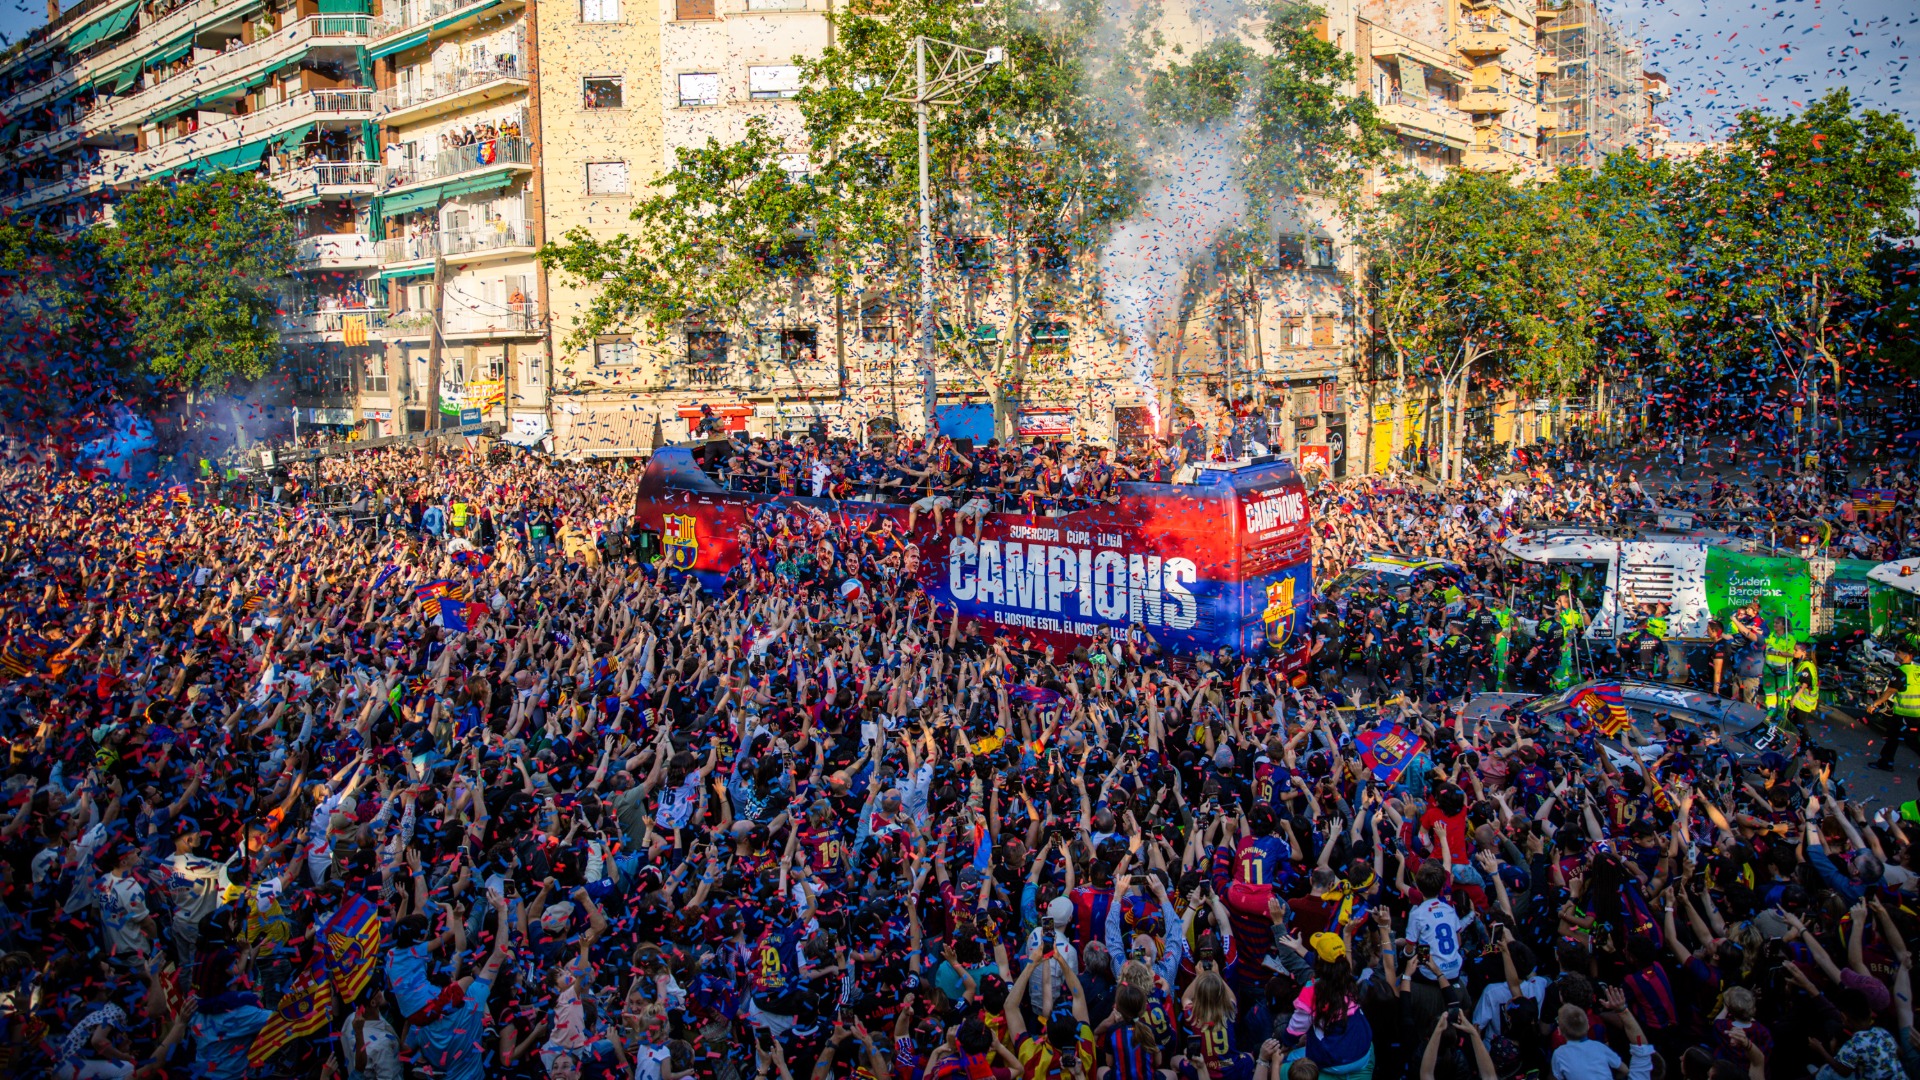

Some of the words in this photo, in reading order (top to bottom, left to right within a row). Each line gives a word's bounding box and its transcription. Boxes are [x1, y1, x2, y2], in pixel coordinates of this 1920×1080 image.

[1246, 492, 1304, 533] CAMPIONS
[1010, 525, 1059, 542] SUPERCOPA
[1067, 530, 1090, 545] COPA
[1097, 533, 1122, 548] LLIGA
[949, 537, 1197, 630] CAMPIONS
[1728, 587, 1782, 597] Barcelona
[1729, 577, 1770, 587] Cuidem
[994, 611, 1004, 624] EL
[1005, 612, 1036, 629] NOSTRE
[1037, 617, 1063, 634] ESTIL,
[1064, 622, 1073, 634] EL
[1075, 622, 1099, 636] NOST
[1039, 712, 1057, 731] 19
[662, 788, 676, 806] 16
[1261, 782, 1272, 803] 19
[1615, 801, 1637, 826] 19
[818, 840, 840, 867] 19
[1241, 859, 1263, 885] 11
[1435, 923, 1455, 955] 8
[761, 947, 780, 977] 19
[1142, 1006, 1167, 1034] 19
[1203, 1026, 1229, 1057] 19
